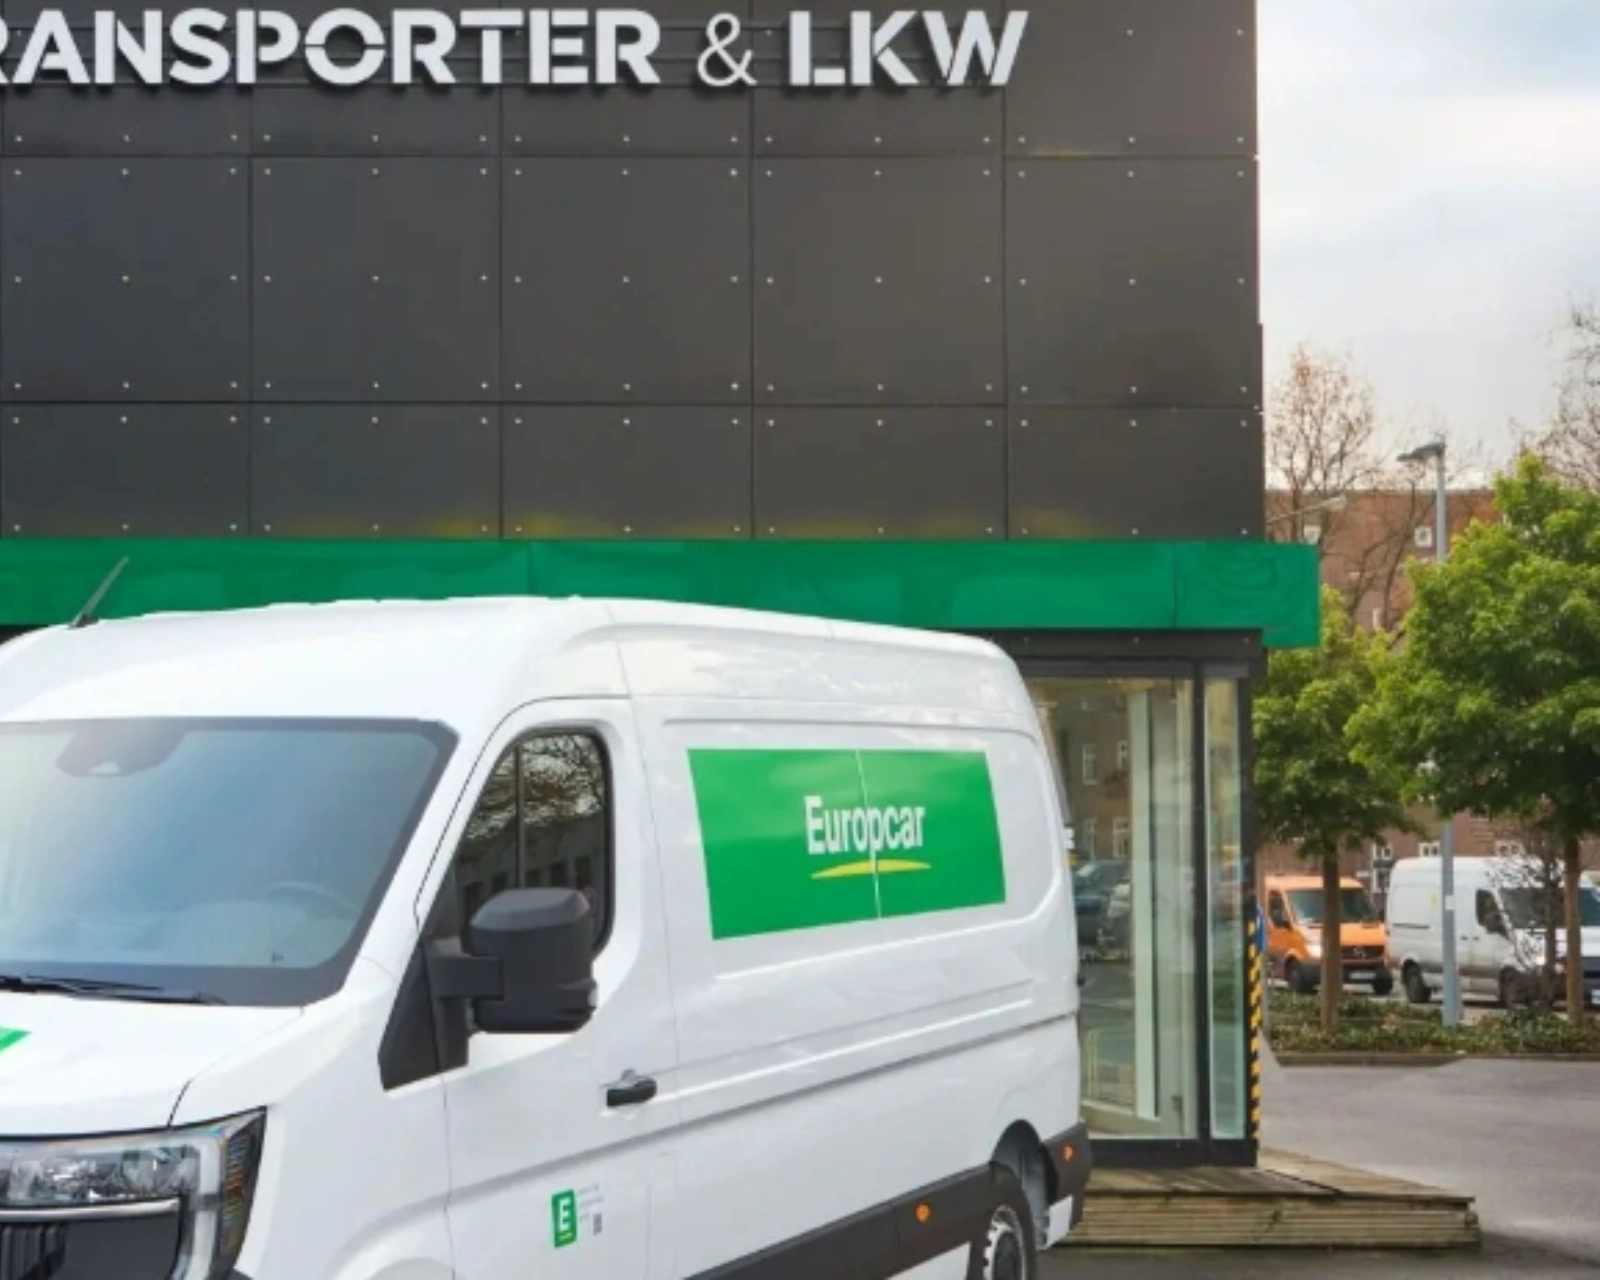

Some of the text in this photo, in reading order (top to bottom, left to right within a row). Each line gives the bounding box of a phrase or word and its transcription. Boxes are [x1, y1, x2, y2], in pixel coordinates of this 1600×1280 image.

[698, 12, 757, 87] &
[789, 10, 1029, 87] LKW
[804, 795, 926, 856] Europcar
